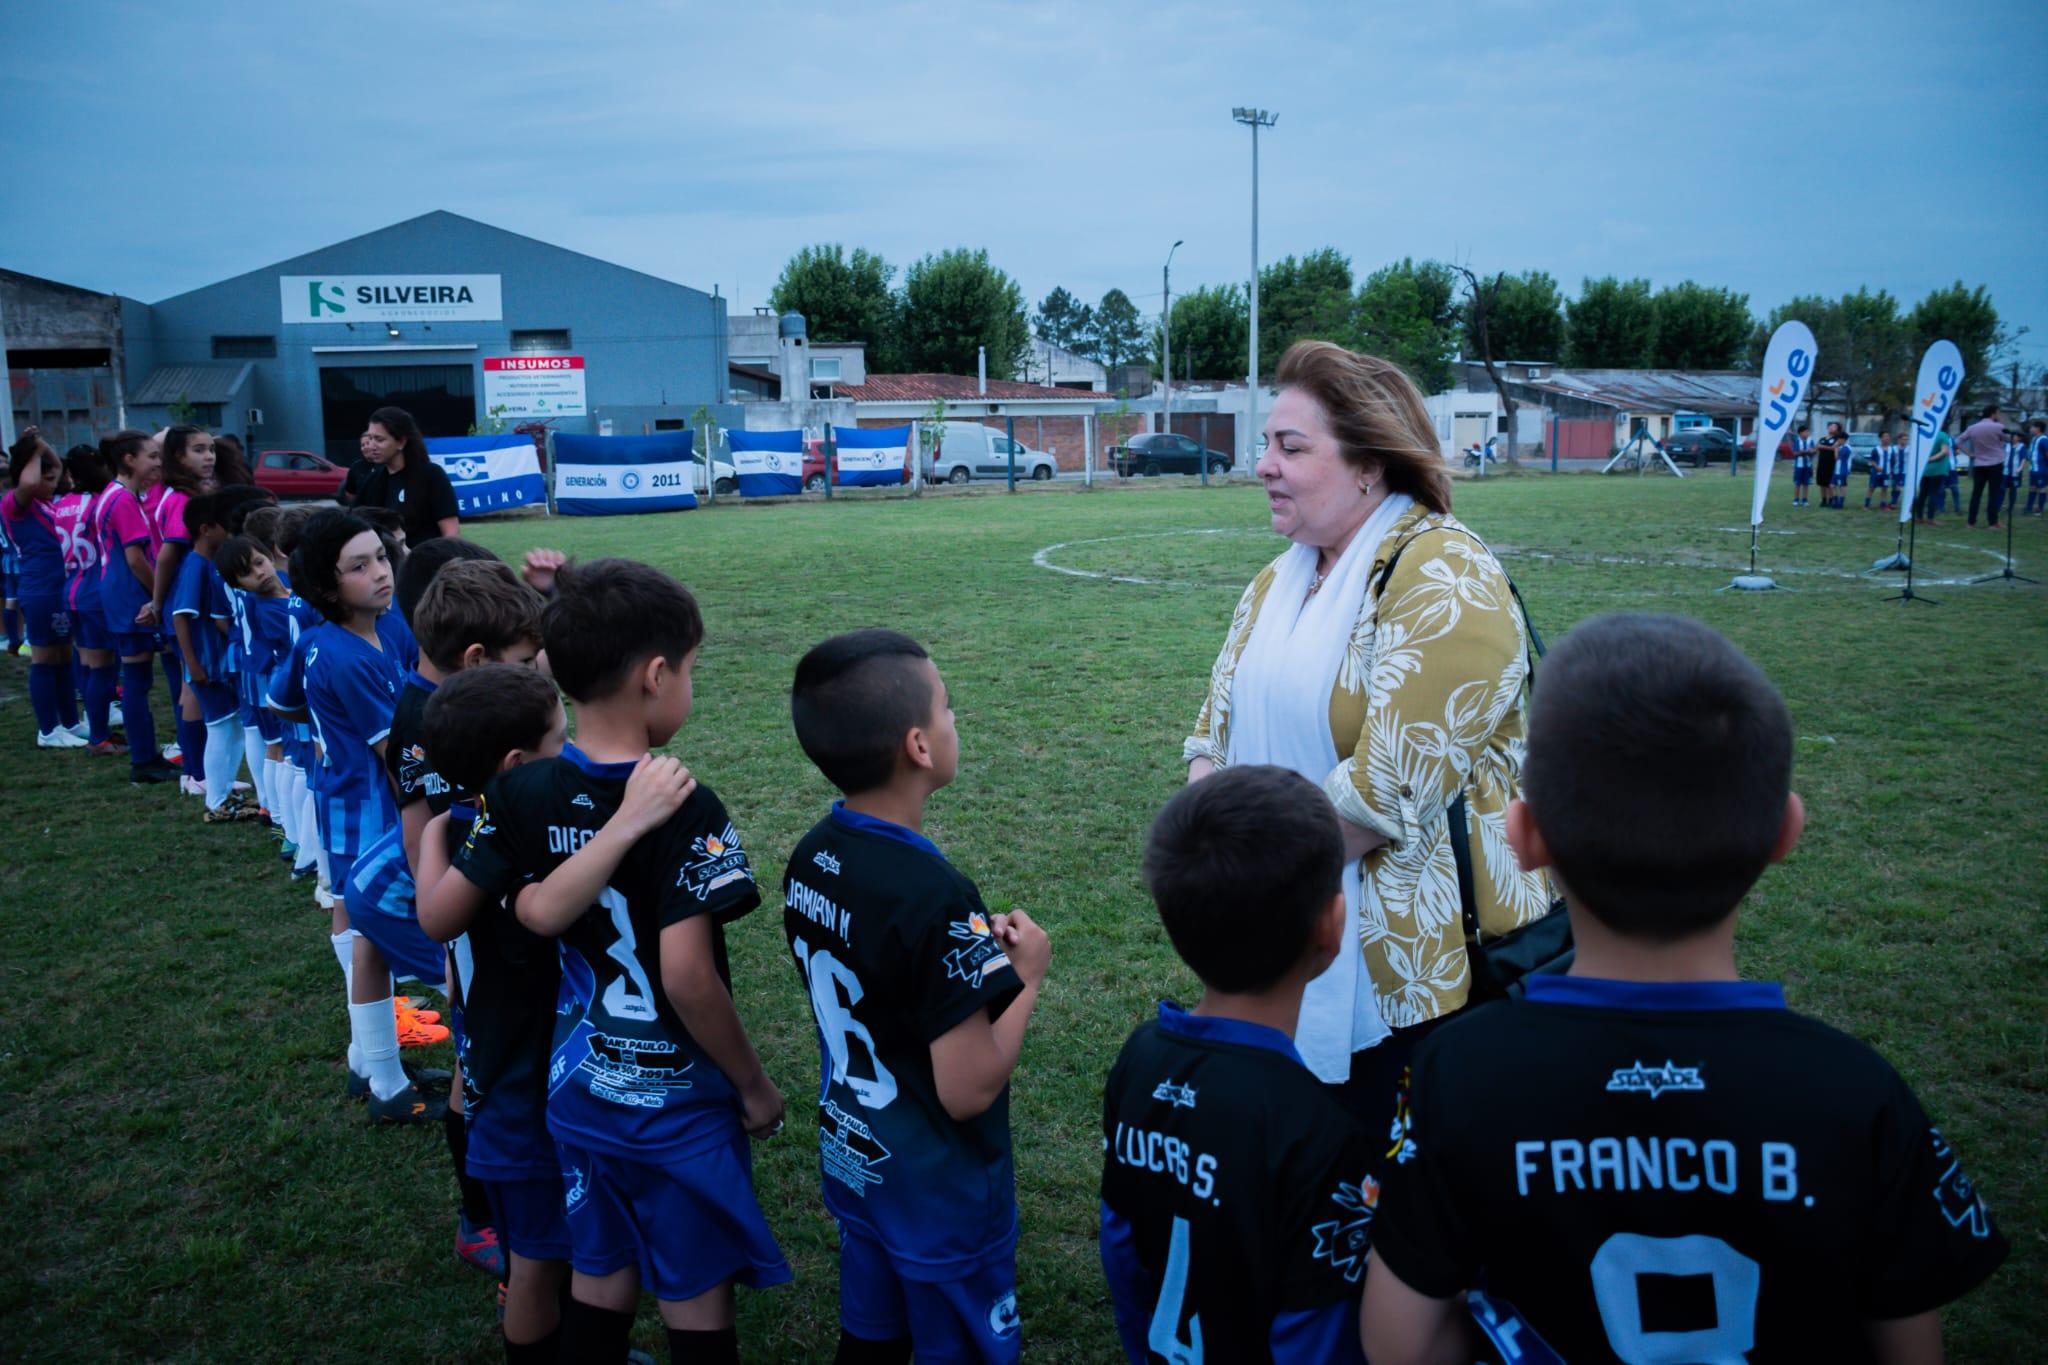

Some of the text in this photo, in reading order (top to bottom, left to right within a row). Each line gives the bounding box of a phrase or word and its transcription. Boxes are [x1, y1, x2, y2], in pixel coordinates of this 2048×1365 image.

[357, 286, 474, 304] SILVEIRA
[501, 359, 571, 370] INSUMOS
[652, 473, 681, 487] 2011
[458, 490, 523, 511] ENINO
[548, 826, 602, 854] DIEG
[793, 935, 898, 1110] 16
[603, 1036, 667, 1052] RANS PAULO
[639, 1069, 661, 1079] 209
[846, 1116, 868, 1135] PAULO
[1193, 1154, 1220, 1207] S.
[1515, 1136, 1815, 1207] FRANCO B.
